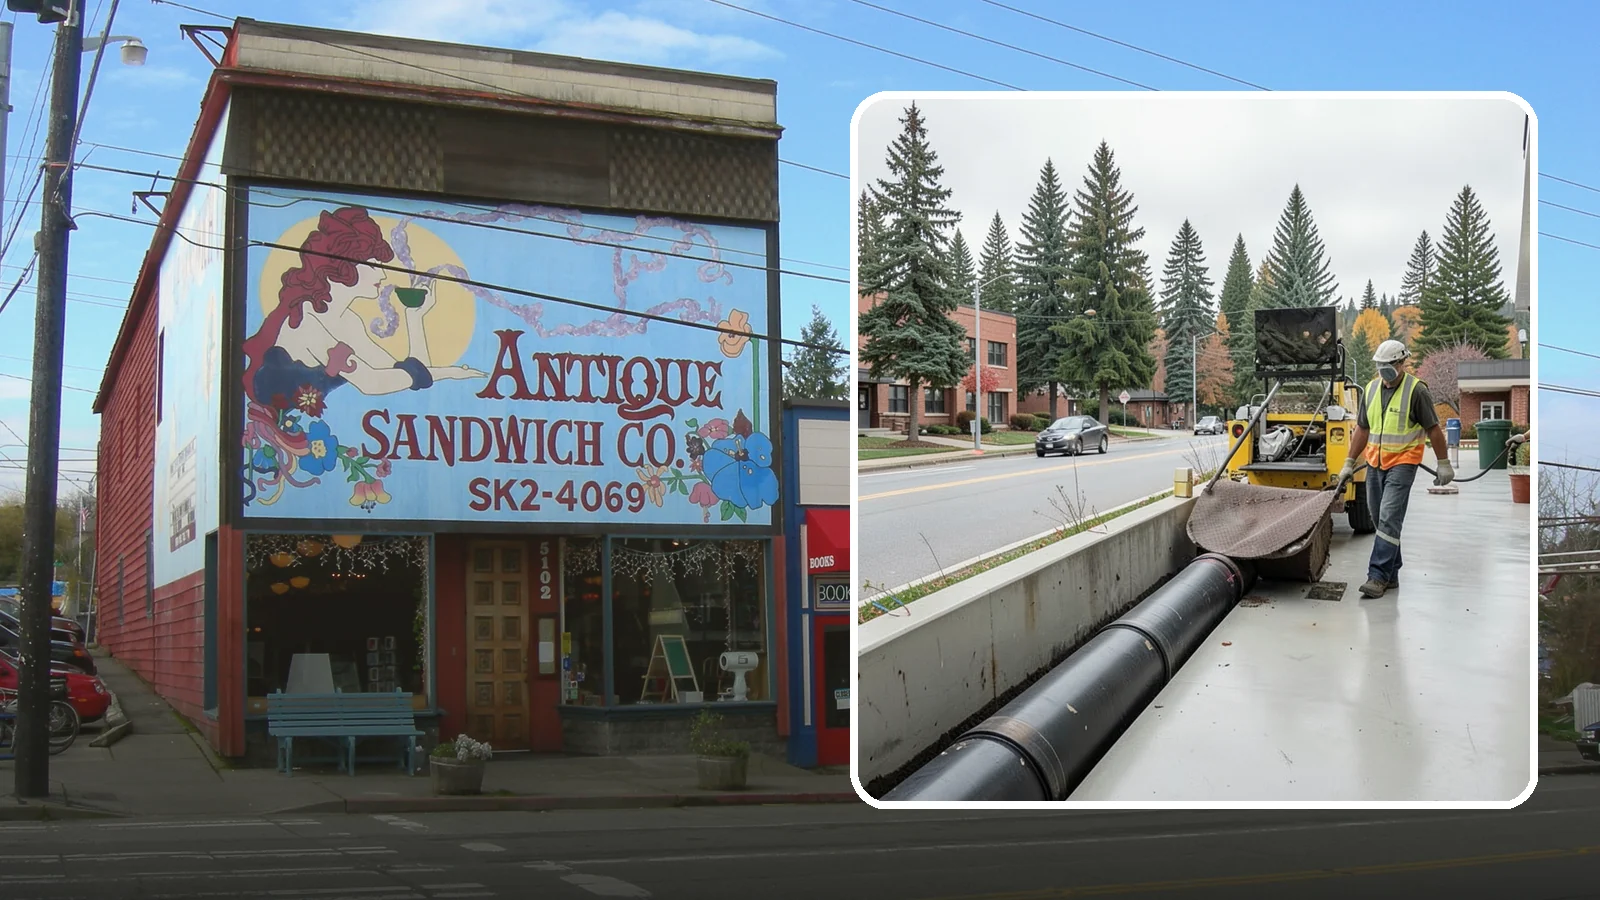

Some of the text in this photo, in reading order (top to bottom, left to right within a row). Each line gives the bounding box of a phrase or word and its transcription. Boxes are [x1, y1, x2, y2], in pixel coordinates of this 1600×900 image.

[476, 329, 723, 420] ANTIQUE
[361, 408, 685, 468] SANDWICH CO.
[469, 477, 645, 513] SK2-4069
[540, 541, 552, 600] 5102
[809, 555, 835, 569] BOOKS
